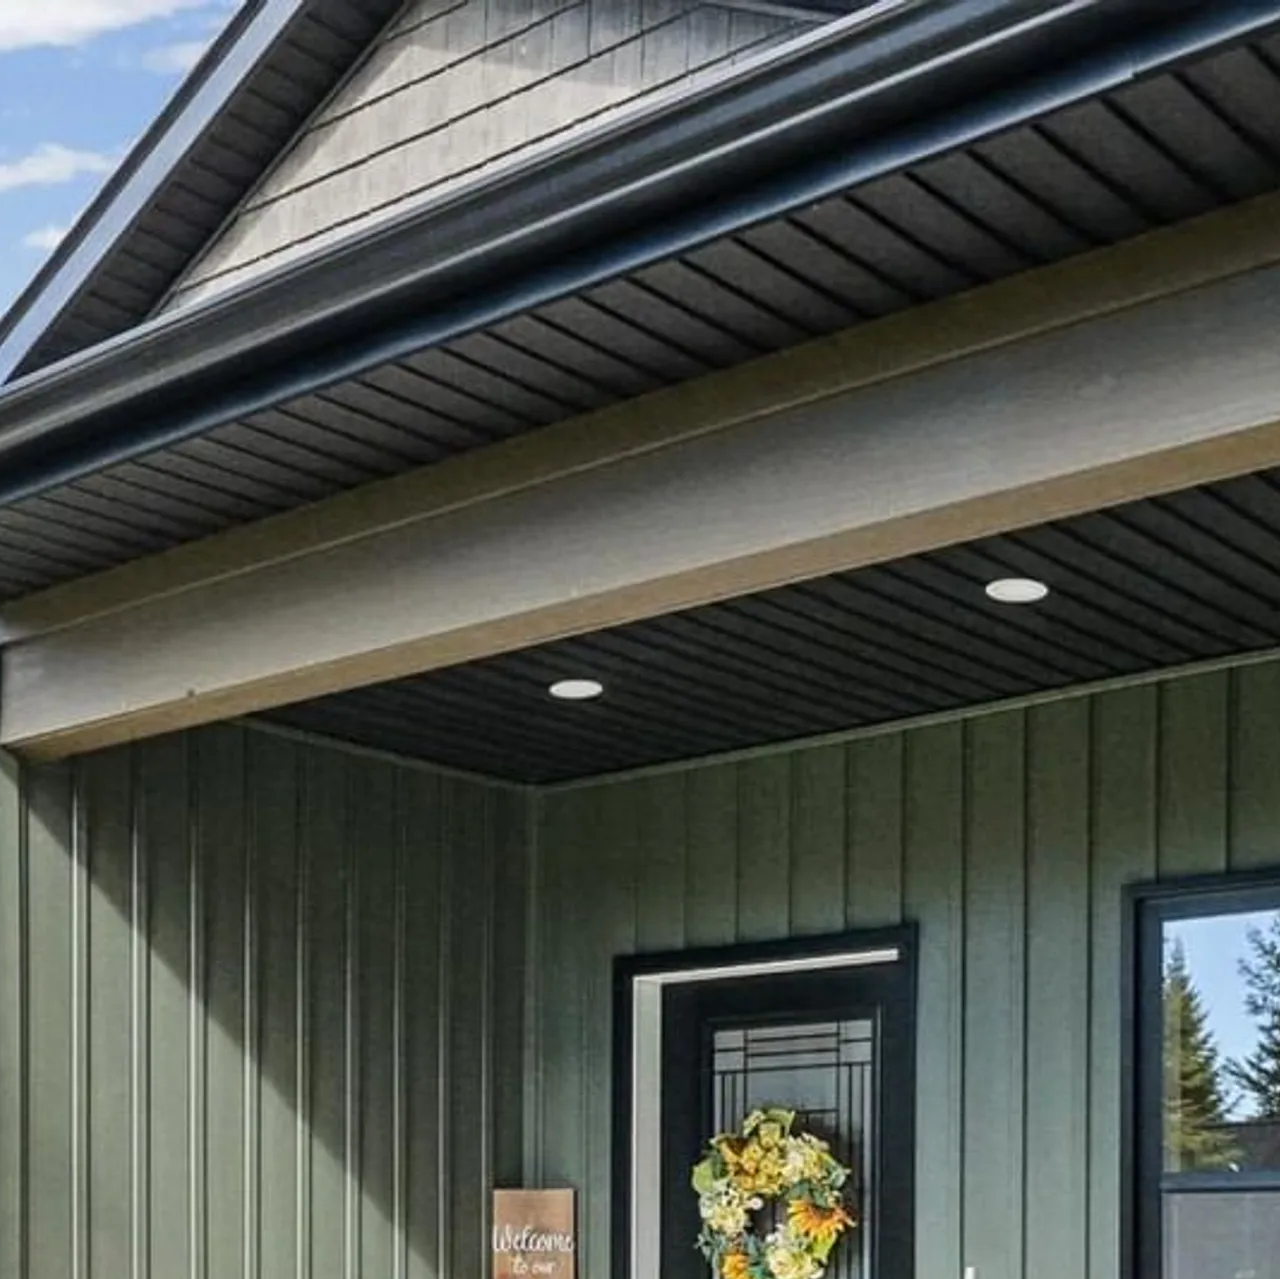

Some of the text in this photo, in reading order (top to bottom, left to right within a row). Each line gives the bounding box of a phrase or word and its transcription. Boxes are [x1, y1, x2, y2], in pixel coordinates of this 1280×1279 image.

[493, 1224, 574, 1252] Welcome
[512, 1253, 556, 1275] to our
